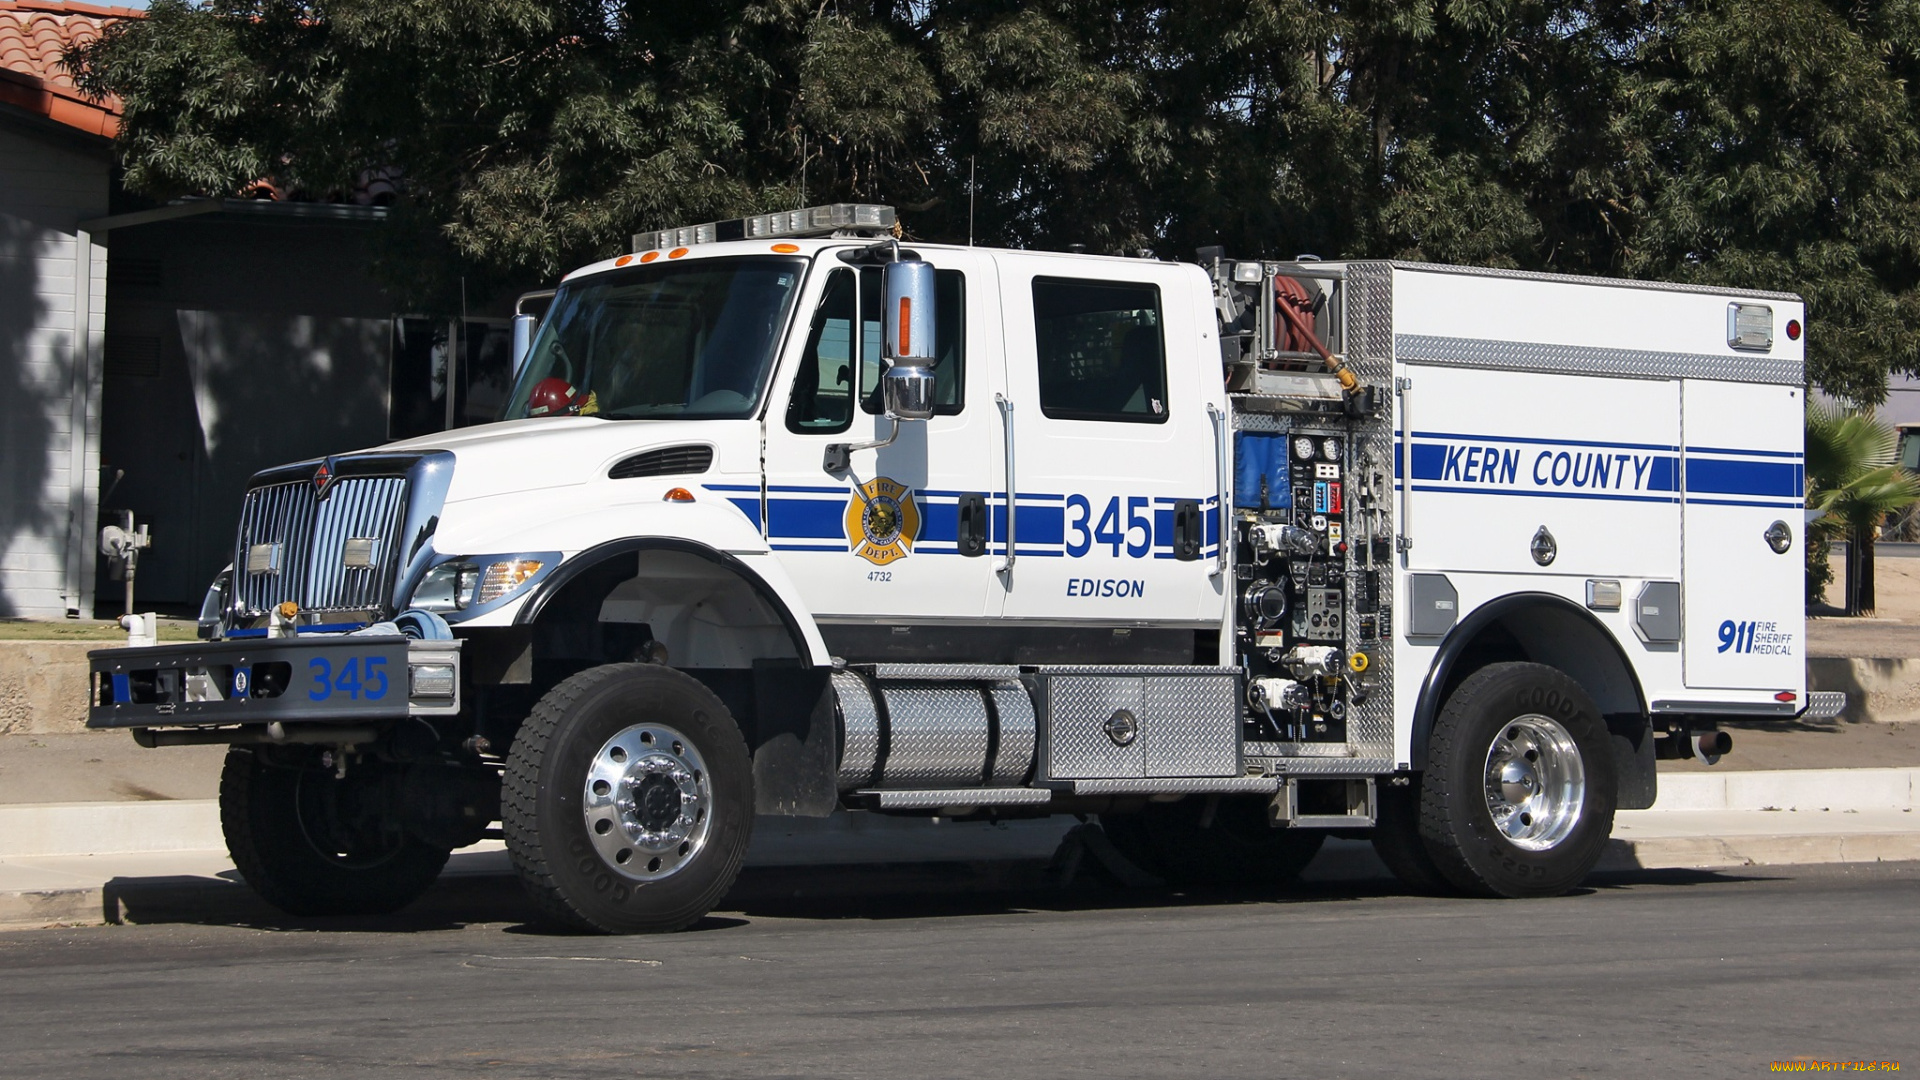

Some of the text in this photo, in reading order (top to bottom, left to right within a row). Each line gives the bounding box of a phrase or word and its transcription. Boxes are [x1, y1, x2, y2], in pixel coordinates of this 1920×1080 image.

[1444, 445, 1650, 490] KERN COUNTY
[868, 482, 898, 495] FIRE
[1066, 493, 1152, 558] 345
[865, 546, 898, 559] DEPT.
[867, 571, 892, 582] 4732
[1066, 578, 1145, 598] EDISON
[1756, 621, 1777, 632] FIRE
[1717, 619, 1756, 654] 911
[1754, 633, 1793, 644] SHERIFF
[1752, 644, 1792, 655] MEDICAL
[309, 656, 388, 702] 345
